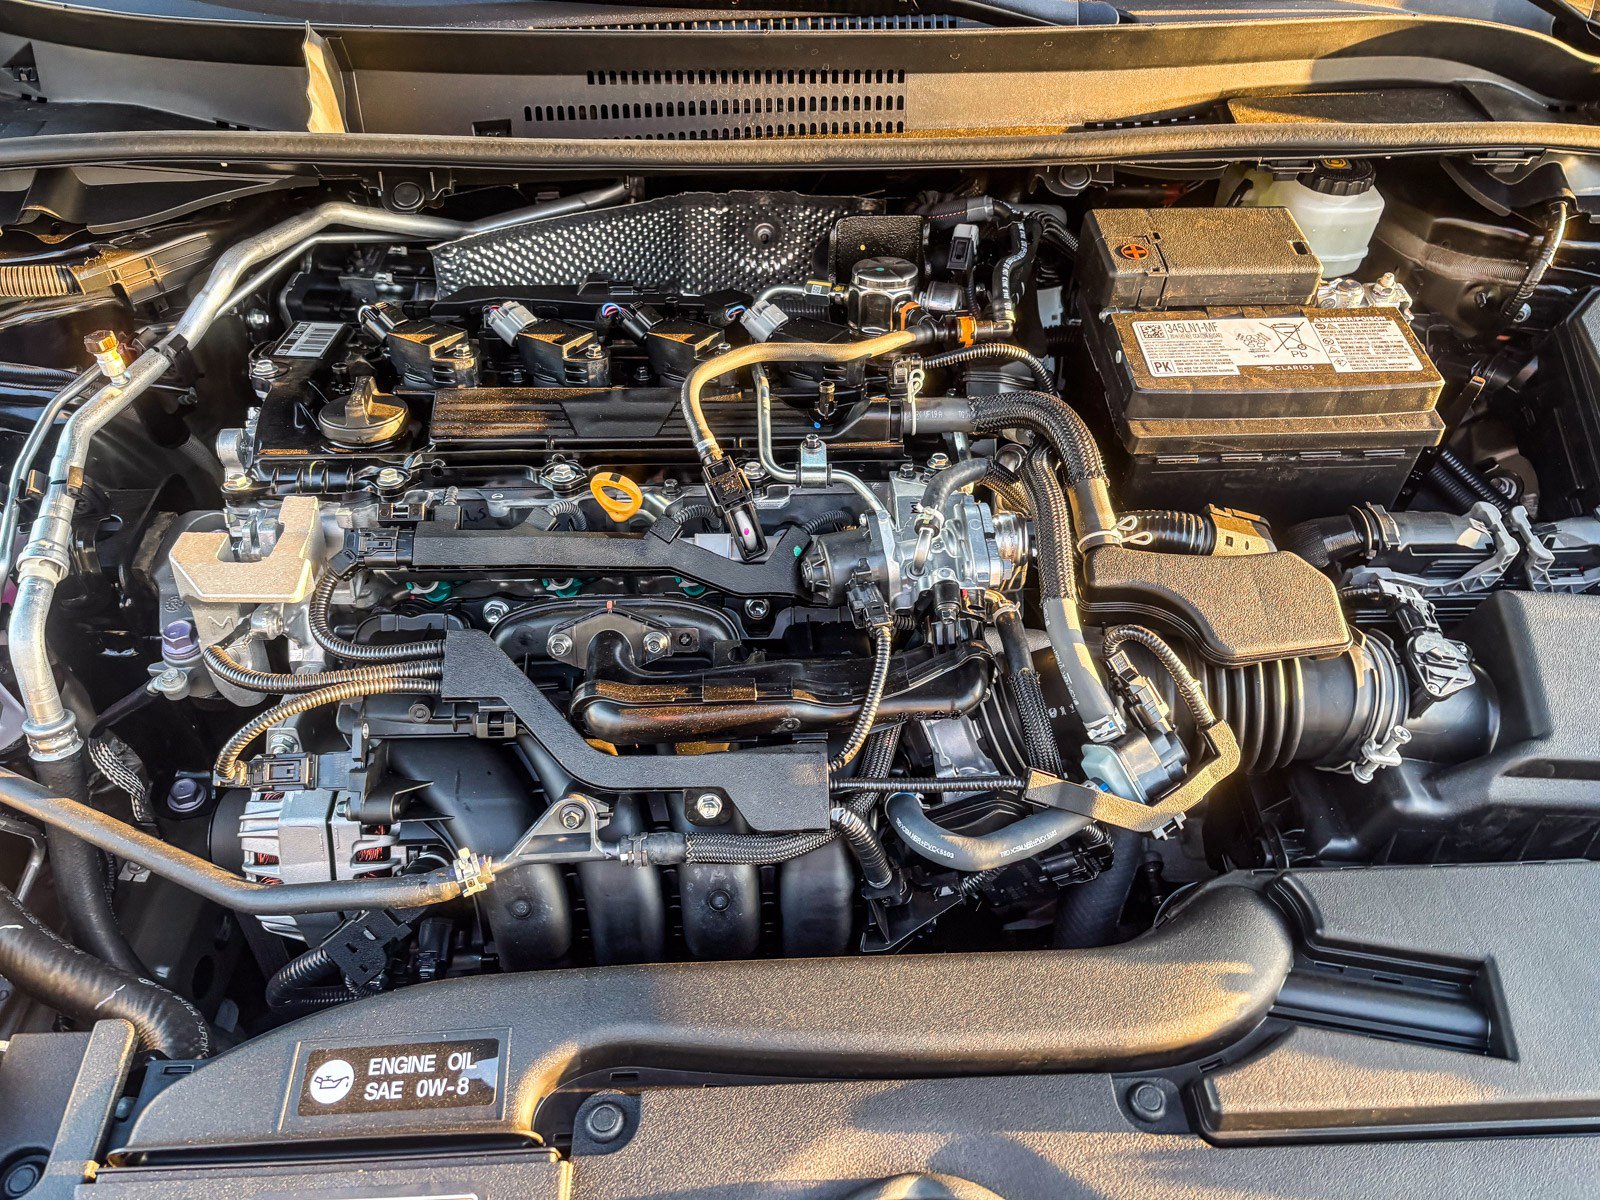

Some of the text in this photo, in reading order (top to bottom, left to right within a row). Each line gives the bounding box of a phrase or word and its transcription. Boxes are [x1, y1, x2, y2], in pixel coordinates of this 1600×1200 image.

[1165, 321, 1218, 334] 345LN1-MF
[1291, 350, 1308, 358] Pb
[1153, 361, 1173, 373] PK
[367, 1051, 478, 1076] ENGINE OIL
[363, 1076, 469, 1101] SAE 0W-8
